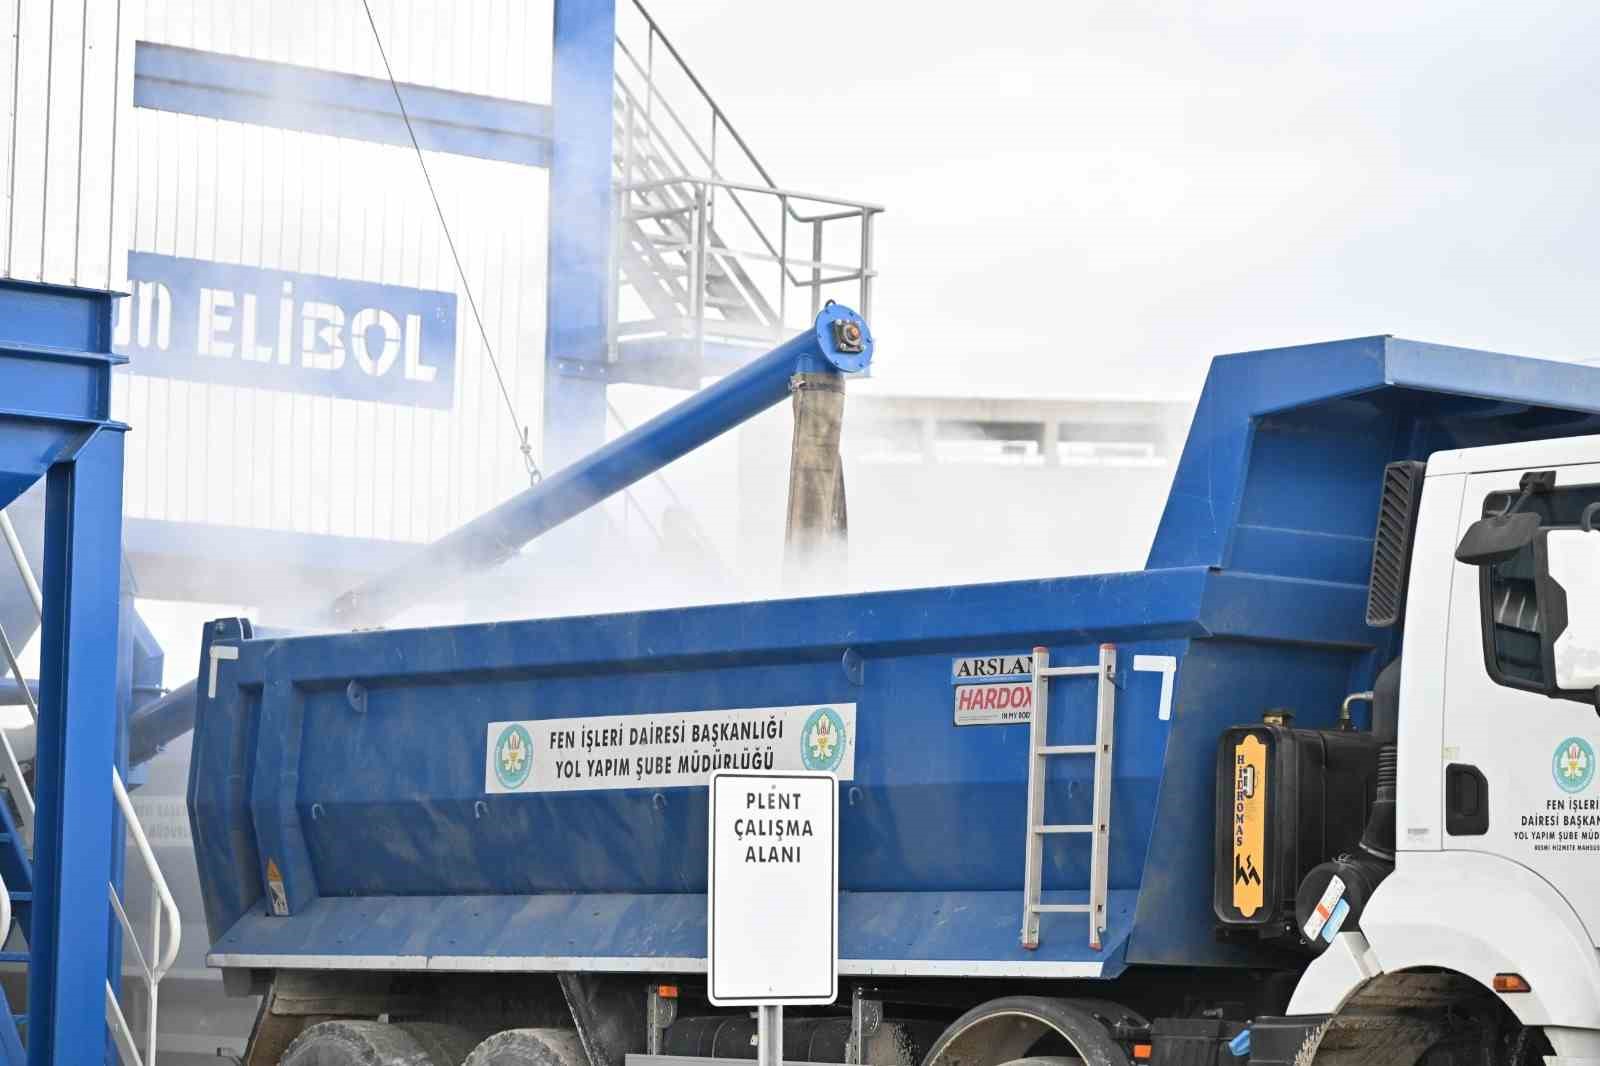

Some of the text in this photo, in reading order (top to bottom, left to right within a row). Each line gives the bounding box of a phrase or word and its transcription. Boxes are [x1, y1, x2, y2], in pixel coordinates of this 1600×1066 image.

[197, 280, 438, 383] ELİBOL
[549, 714, 784, 753] FEN İŞLERİ DAİRESİ BAŞKANLIĞI
[555, 746, 775, 781] YOL YAPIM ŞUBE MÜDÜRLÜĞÜ
[746, 792, 802, 810] PLENT
[1546, 796, 1599, 812] FEN İŞLERİ
[1521, 812, 1559, 826] DAİRESİ
[734, 818, 815, 842] ÇALIŞMA
[1514, 831, 1529, 840] YOL
[1532, 831, 1555, 840] YAPIM
[1558, 831, 1578, 842] ŞUBE
[745, 846, 802, 863] ALANI
